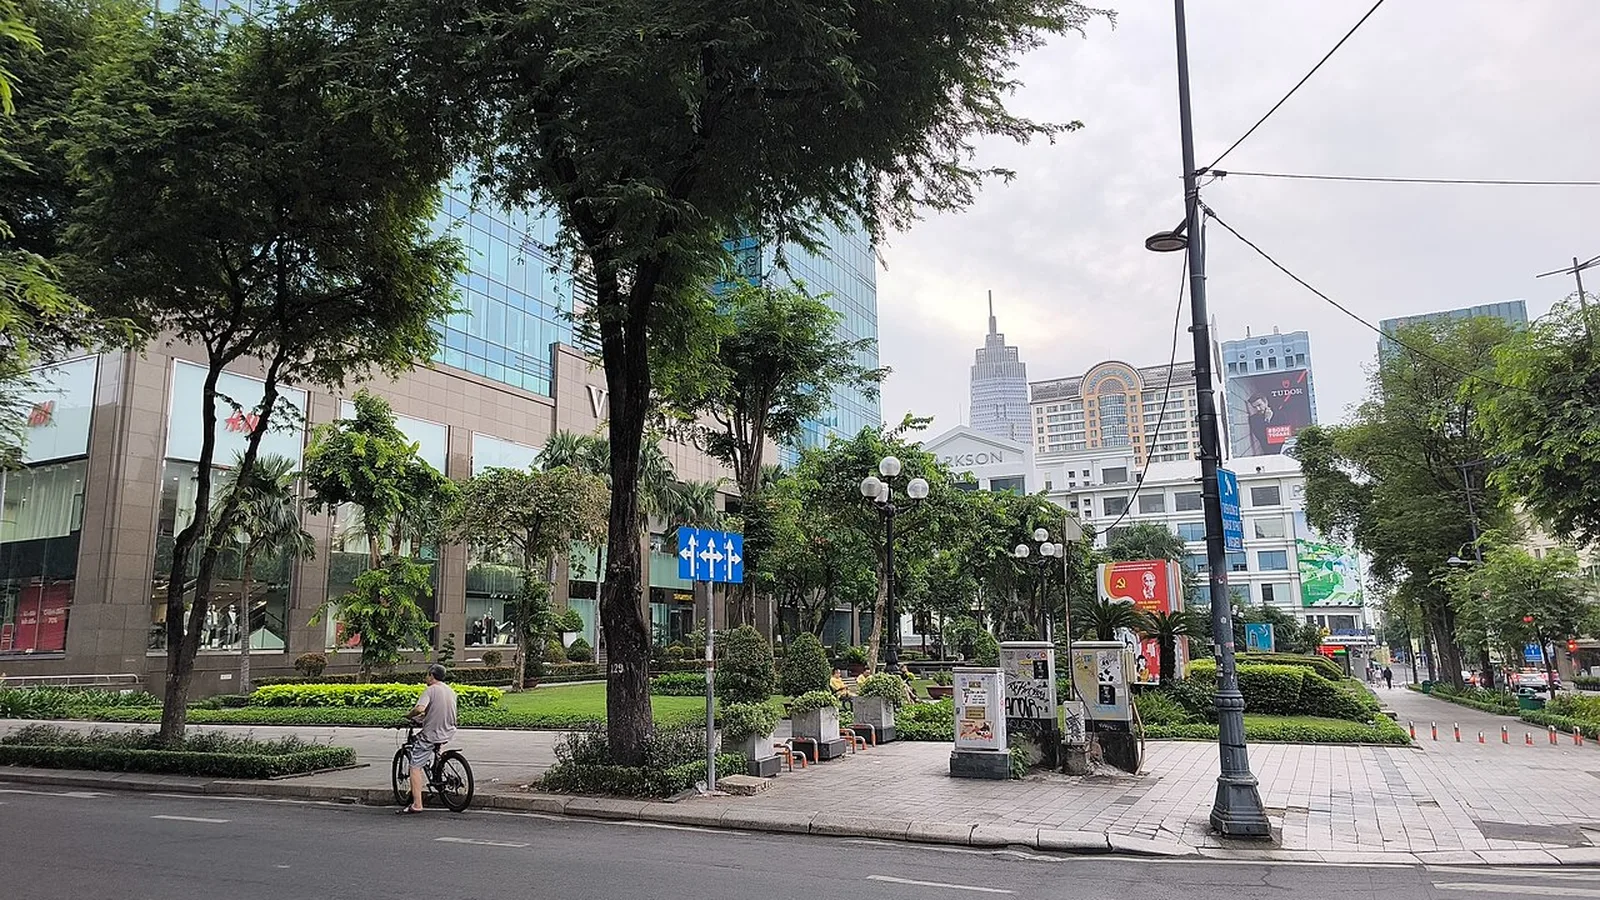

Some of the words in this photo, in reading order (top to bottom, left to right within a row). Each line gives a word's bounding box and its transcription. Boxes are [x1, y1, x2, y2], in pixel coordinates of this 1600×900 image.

[1271, 388, 1303, 397] TUDOR
[935, 451, 1003, 468] RKSON
[610, 663, 624, 674] 129
